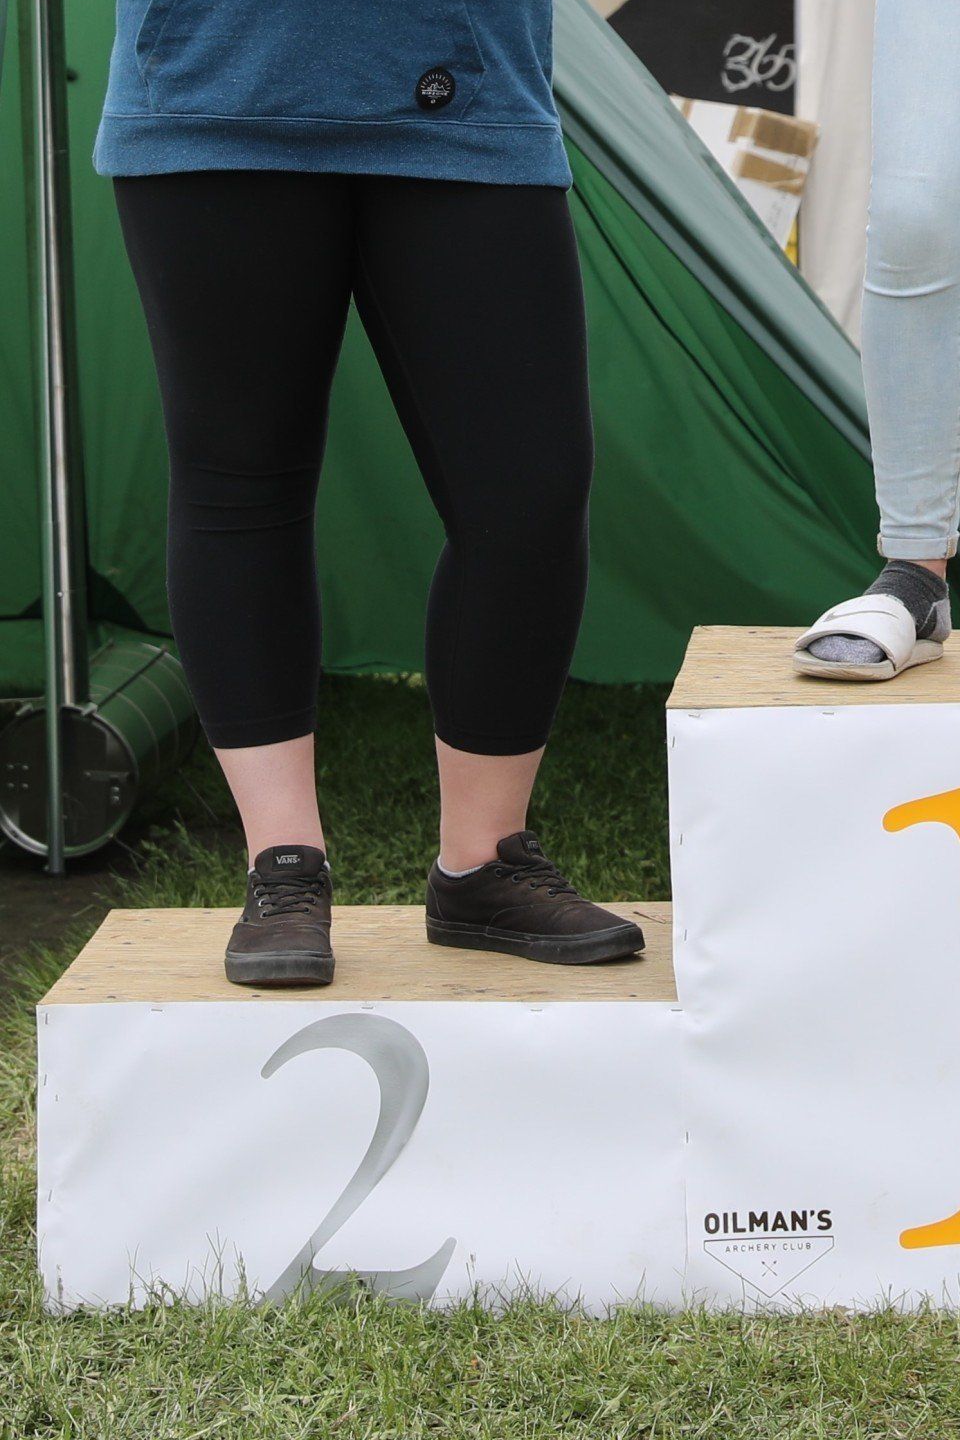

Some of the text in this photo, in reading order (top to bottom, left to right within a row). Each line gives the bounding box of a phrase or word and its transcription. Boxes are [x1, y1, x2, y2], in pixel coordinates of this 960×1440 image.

[276, 854, 299, 865] VANS
[260, 1013, 458, 1308] 2
[704, 1209, 833, 1234] OILMAN'S
[725, 1242, 812, 1253] ARCHERY CLUB
